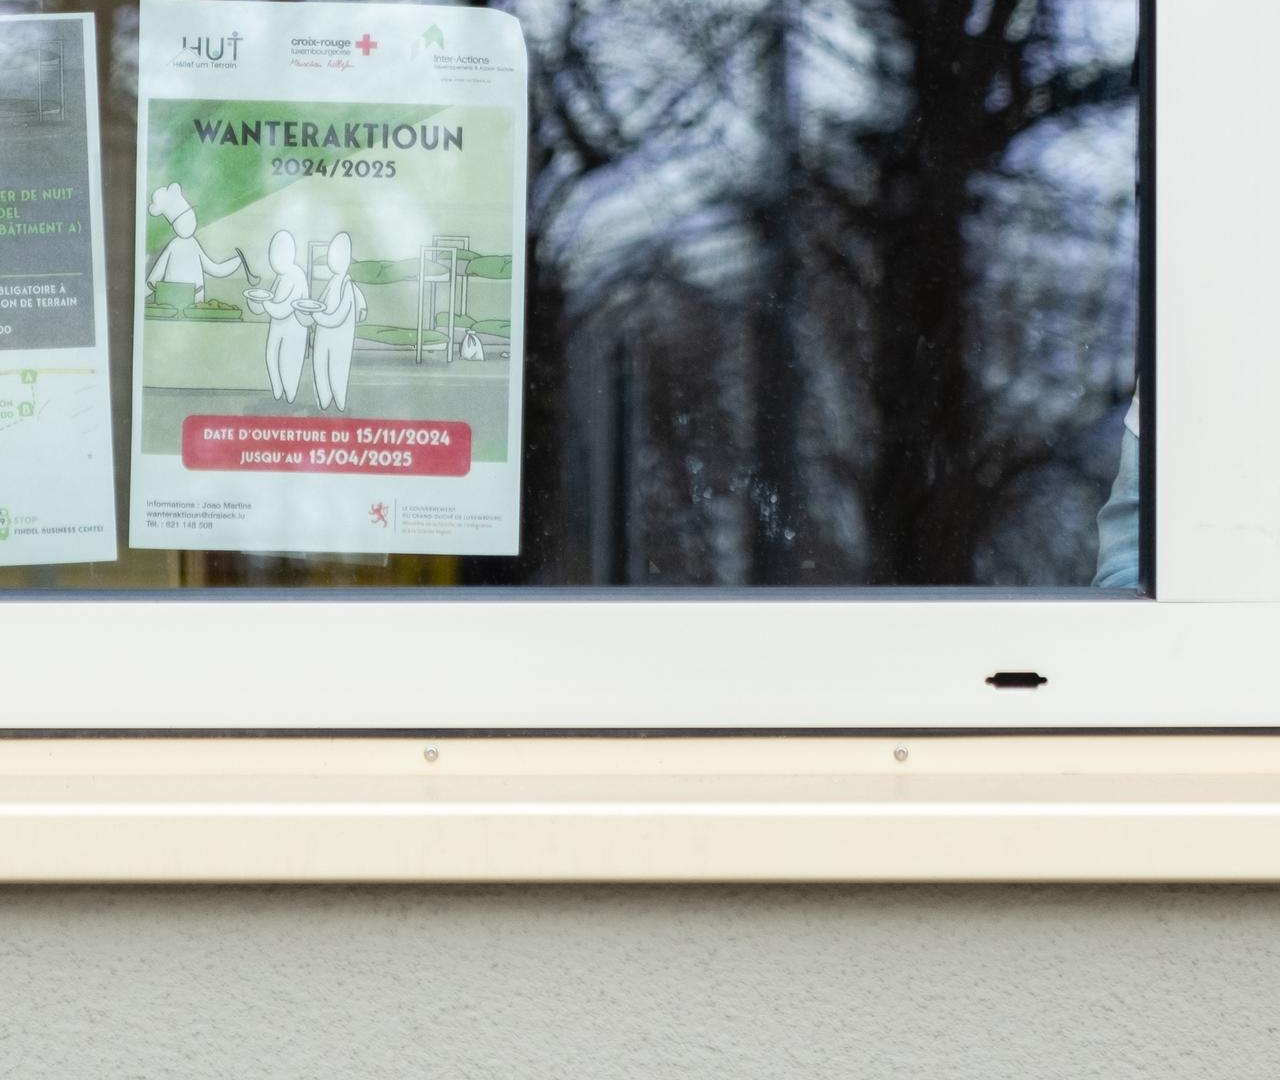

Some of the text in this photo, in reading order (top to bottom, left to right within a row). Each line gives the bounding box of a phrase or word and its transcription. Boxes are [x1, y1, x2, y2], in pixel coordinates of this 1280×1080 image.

[183, 31, 243, 61] HUT
[291, 37, 351, 48] croix-rouge
[211, 61, 237, 69] Terrain
[434, 55, 489, 64] Inter-Actions
[194, 119, 463, 152] WANTERAKTIOUN
[271, 157, 396, 178] 2024/2025
[21, 190, 37, 201] DE
[43, 188, 73, 200] NUIT
[69, 222, 82, 233] A)
[59, 283, 66, 293] À
[21, 298, 32, 307] DE
[36, 297, 77, 307] TERRAIN
[204, 428, 450, 446] DATE D'OUVERTURE DU 15/11/2024
[240, 449, 412, 467] JUSQU'AU 15/04/2025
[146, 500, 195, 509] Informations
[14, 516, 37, 524] STOP
[14, 527, 39, 535] FINDEL
